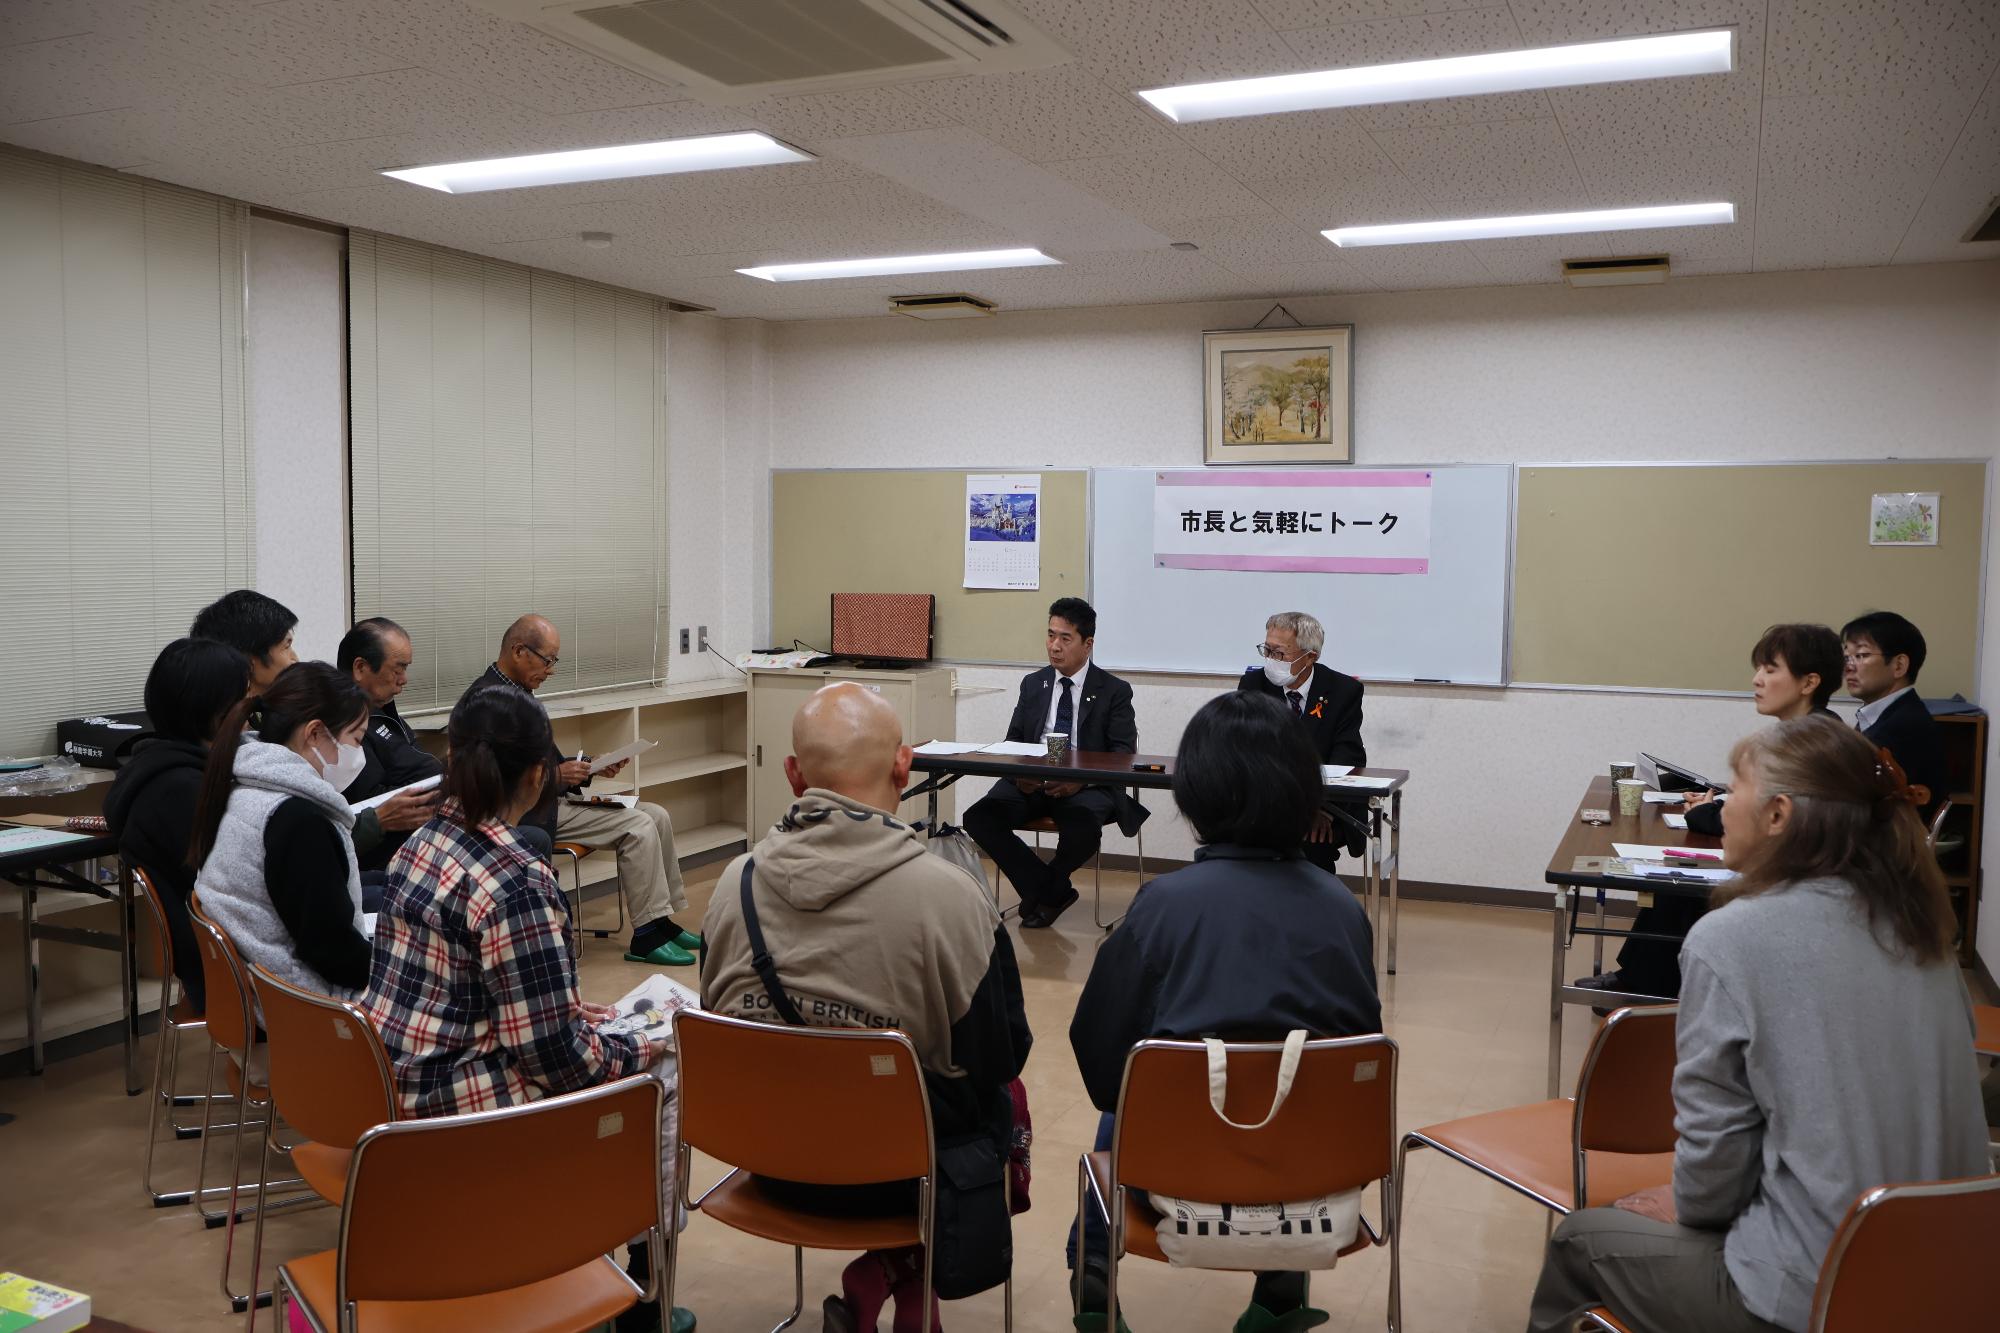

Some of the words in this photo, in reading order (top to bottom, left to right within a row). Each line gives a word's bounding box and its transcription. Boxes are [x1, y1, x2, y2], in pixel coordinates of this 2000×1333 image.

[1180, 509, 1399, 535] 市長と気軽にトーク
[743, 993, 803, 1013] BON
[813, 1000, 901, 1029] BRITISH
